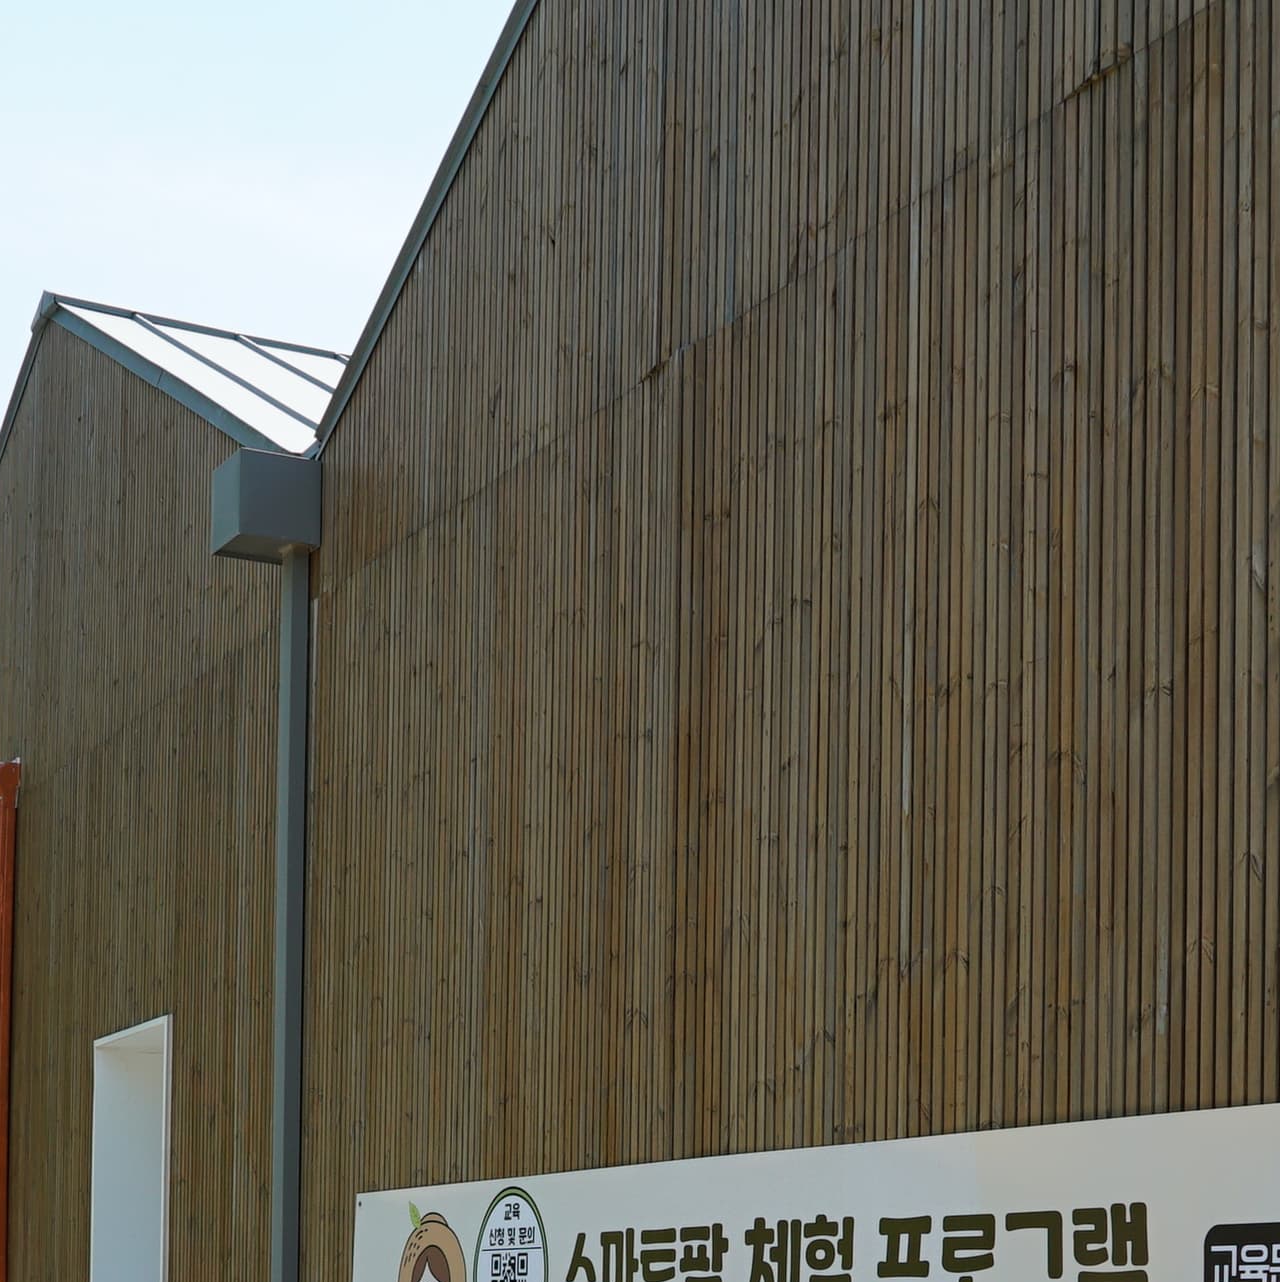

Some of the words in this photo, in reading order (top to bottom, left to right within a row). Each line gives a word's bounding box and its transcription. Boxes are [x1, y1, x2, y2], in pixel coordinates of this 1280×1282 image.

[504, 1203, 520, 1220] 교육
[489, 1227, 505, 1246] 신청
[507, 1227, 516, 1246] 및
[518, 1226, 535, 1245] 문의
